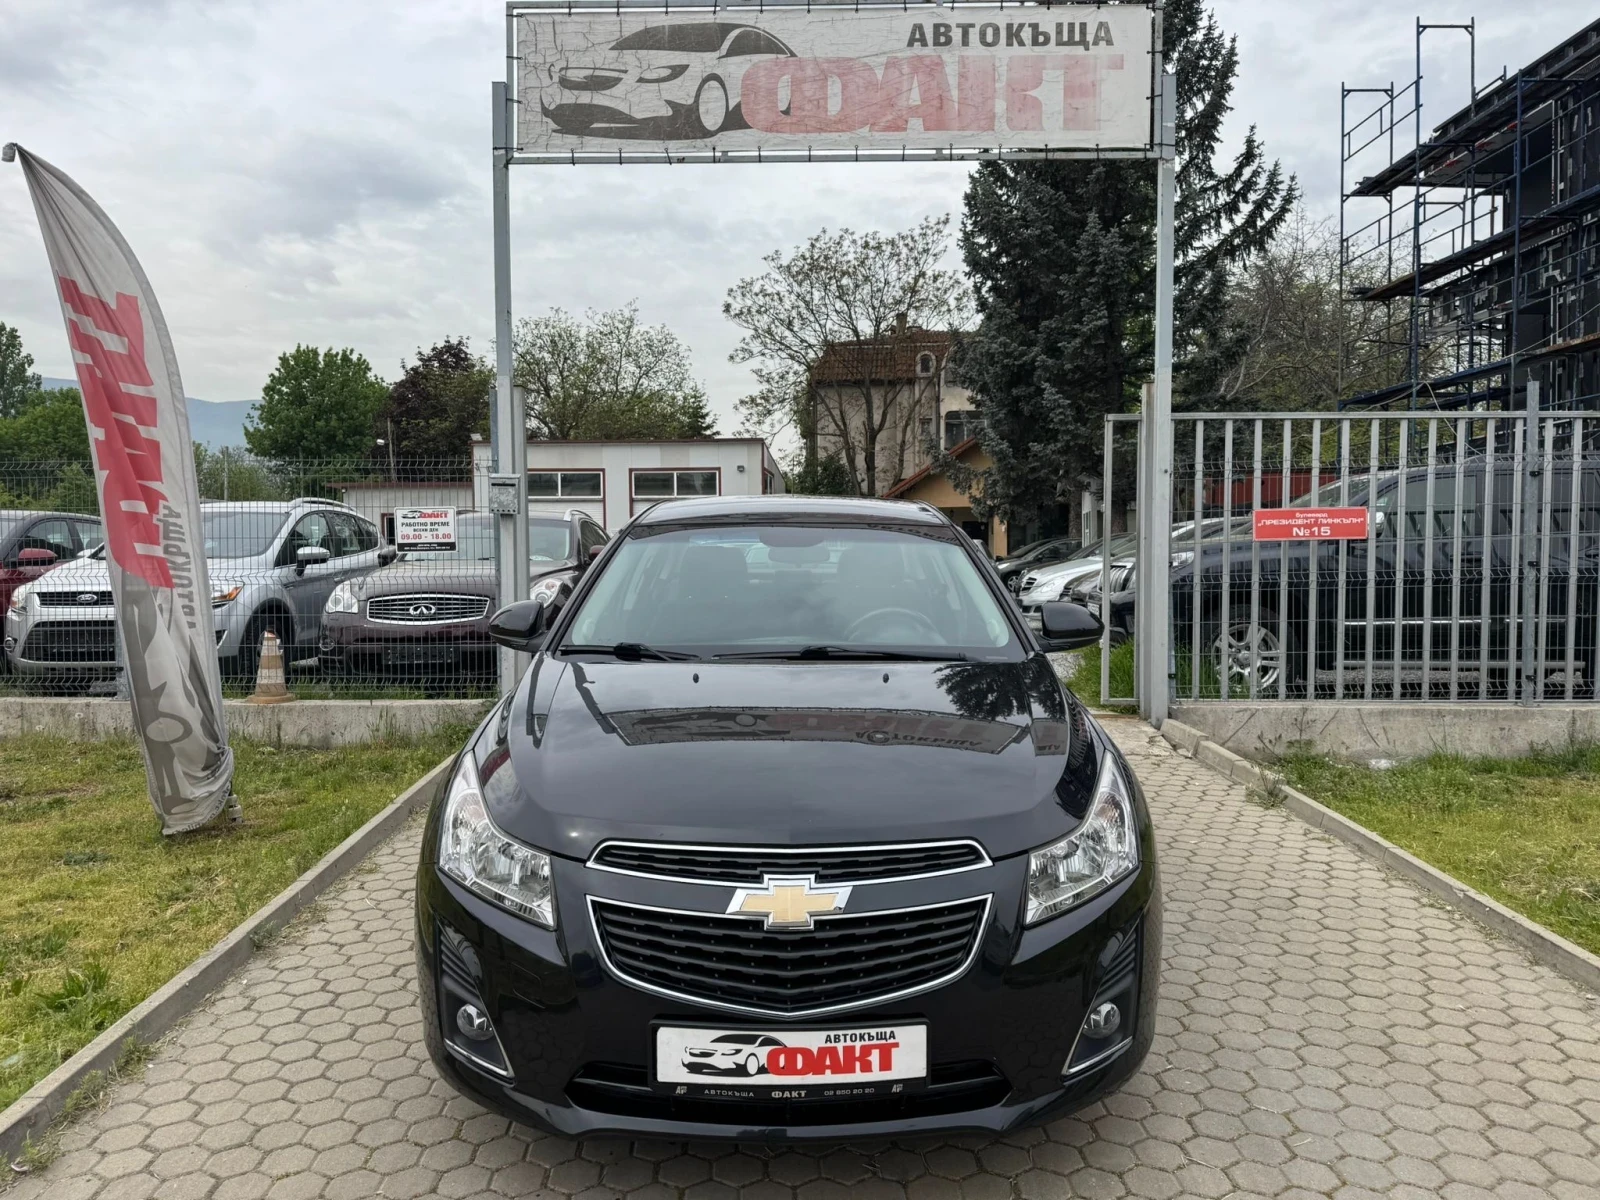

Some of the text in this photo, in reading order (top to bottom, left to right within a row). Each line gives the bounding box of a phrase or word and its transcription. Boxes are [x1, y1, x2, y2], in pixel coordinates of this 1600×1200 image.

[907, 21, 1114, 50] АВТОКЪЩА
[740, 54, 1124, 133] ФАКТ
[824, 1030, 896, 1045] АВТОКЪЩА
[766, 1041, 900, 1077] ФАКТ
[771, 1090, 807, 1099] ФАКТ
